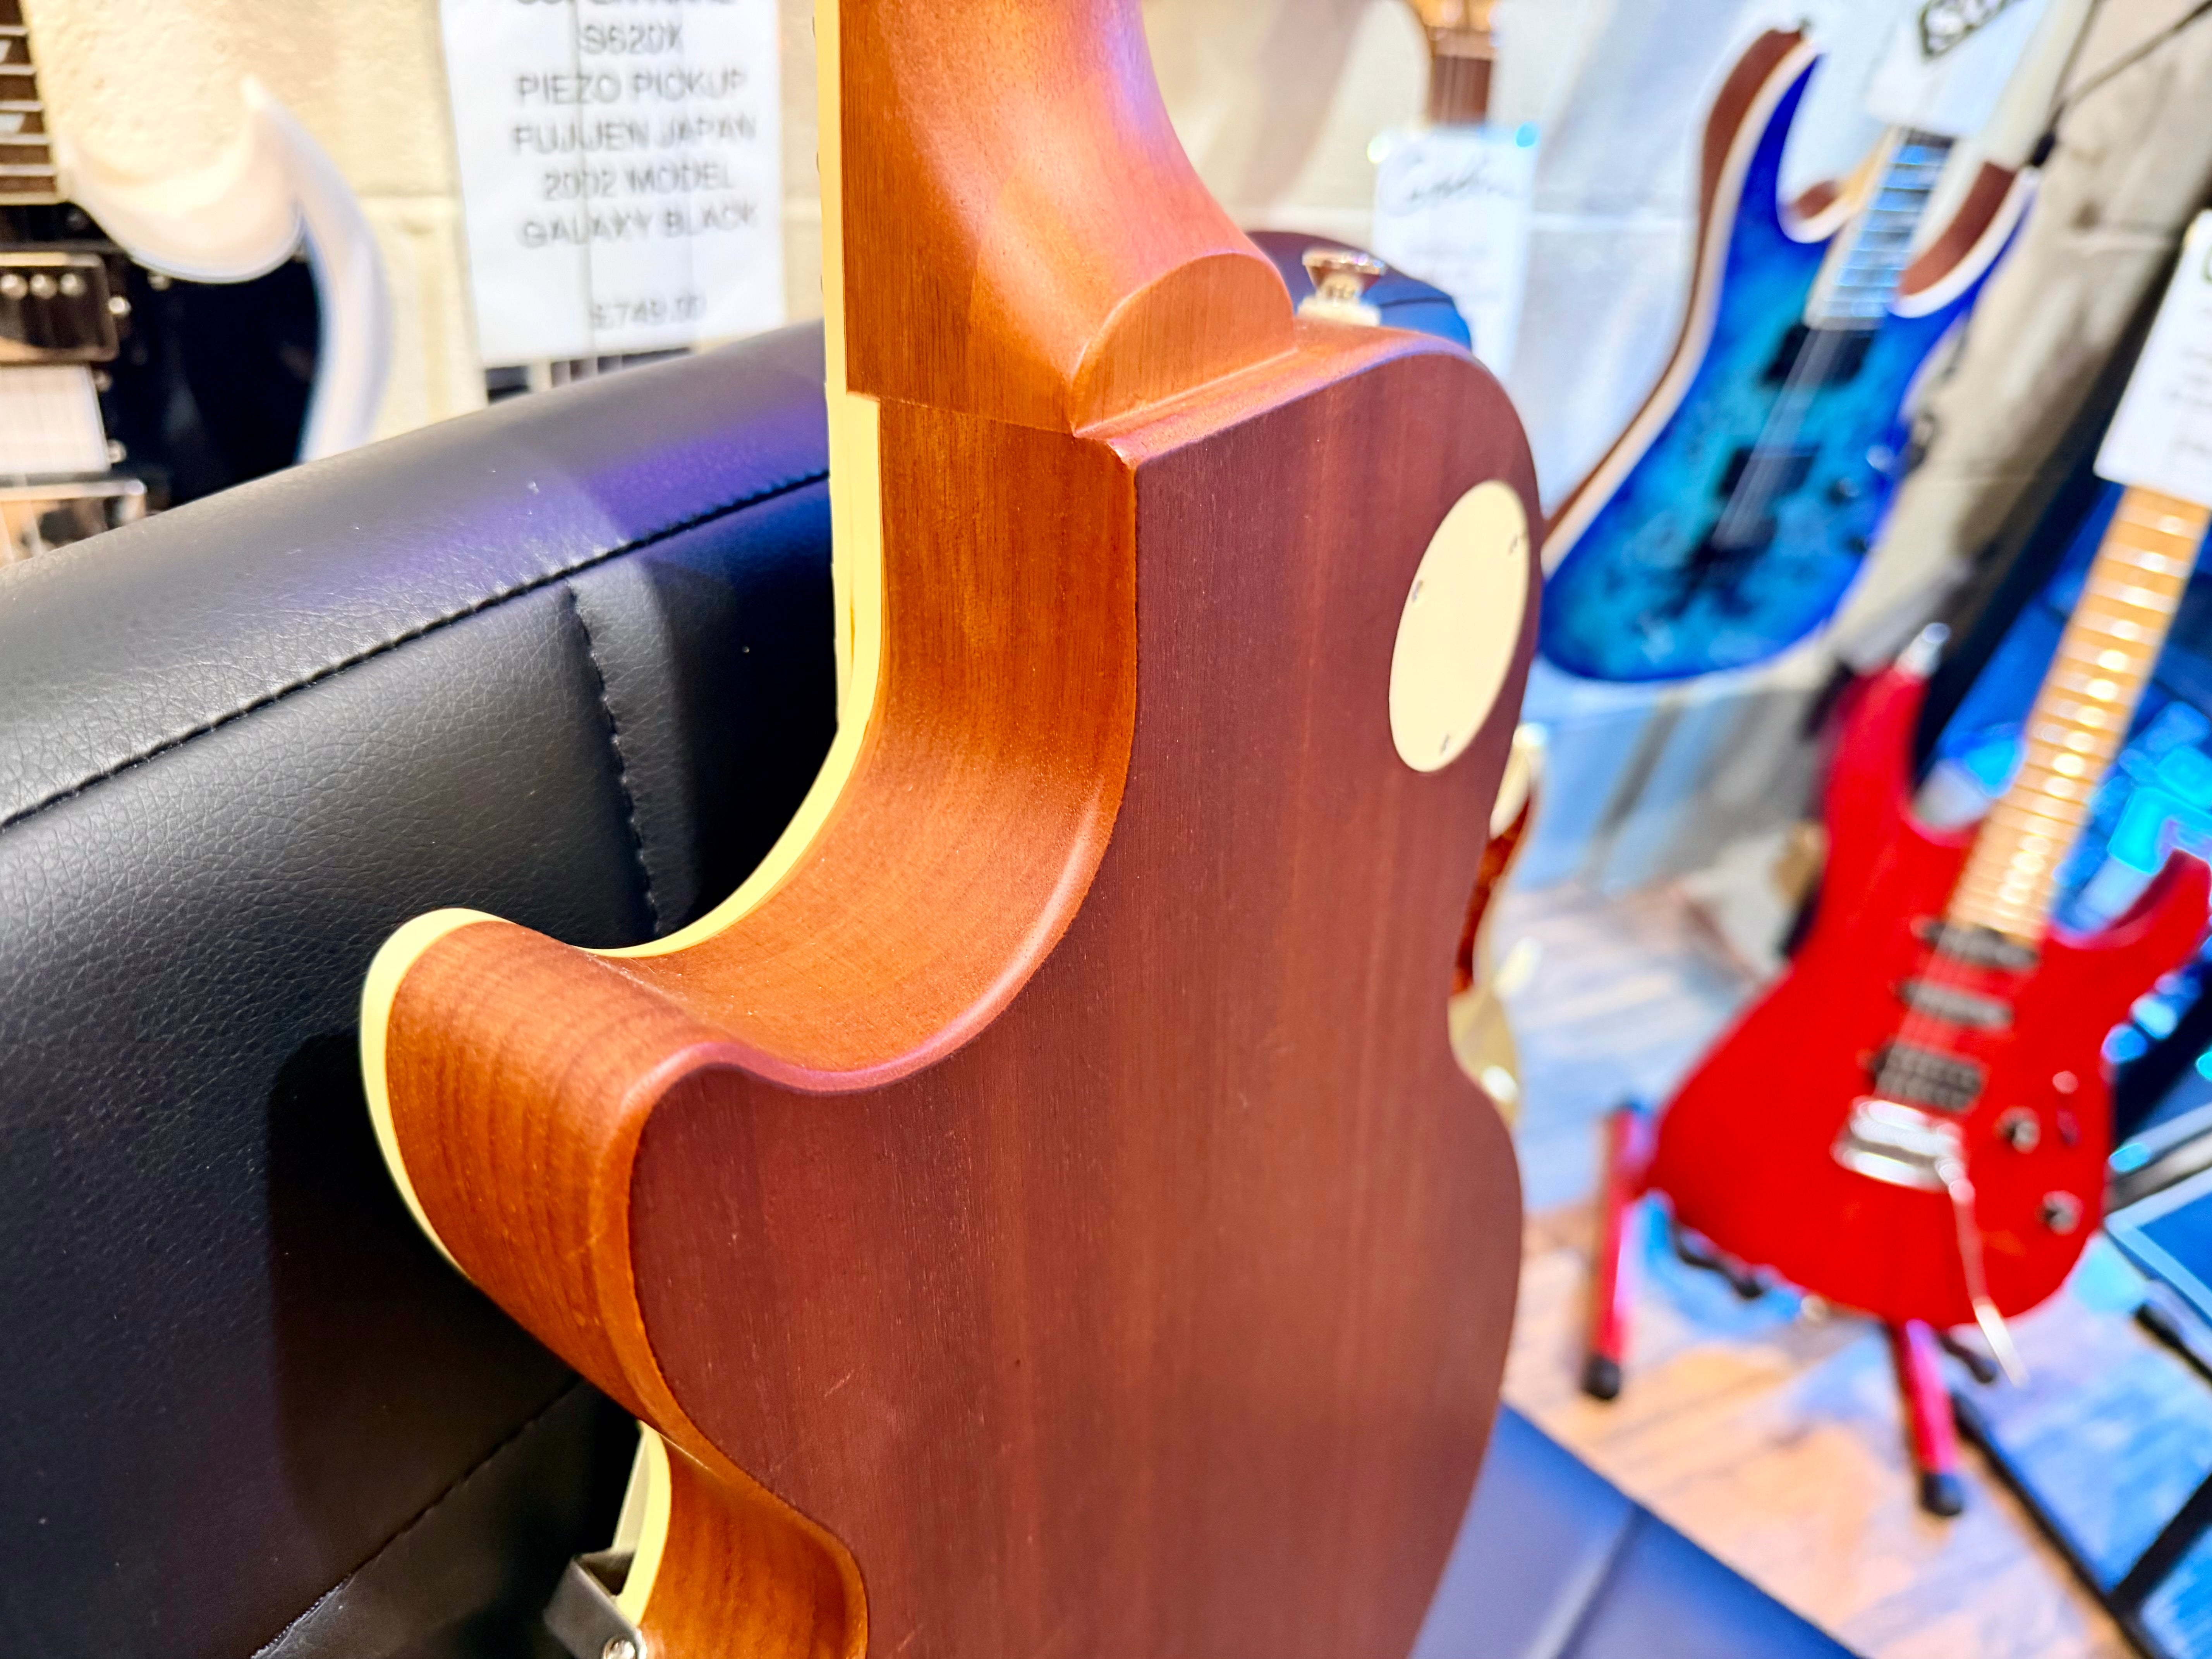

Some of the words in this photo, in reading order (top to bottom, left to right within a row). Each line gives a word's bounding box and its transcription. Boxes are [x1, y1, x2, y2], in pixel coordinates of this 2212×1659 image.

[515, 71, 622, 105] PIEZO
[630, 67, 747, 103] PICKUP
[657, 113, 757, 150] JAPAN
[542, 168, 617, 201] 2002
[624, 161, 736, 195] MODEL
[518, 211, 652, 249] GALAXY
[661, 201, 757, 238] BLACK
